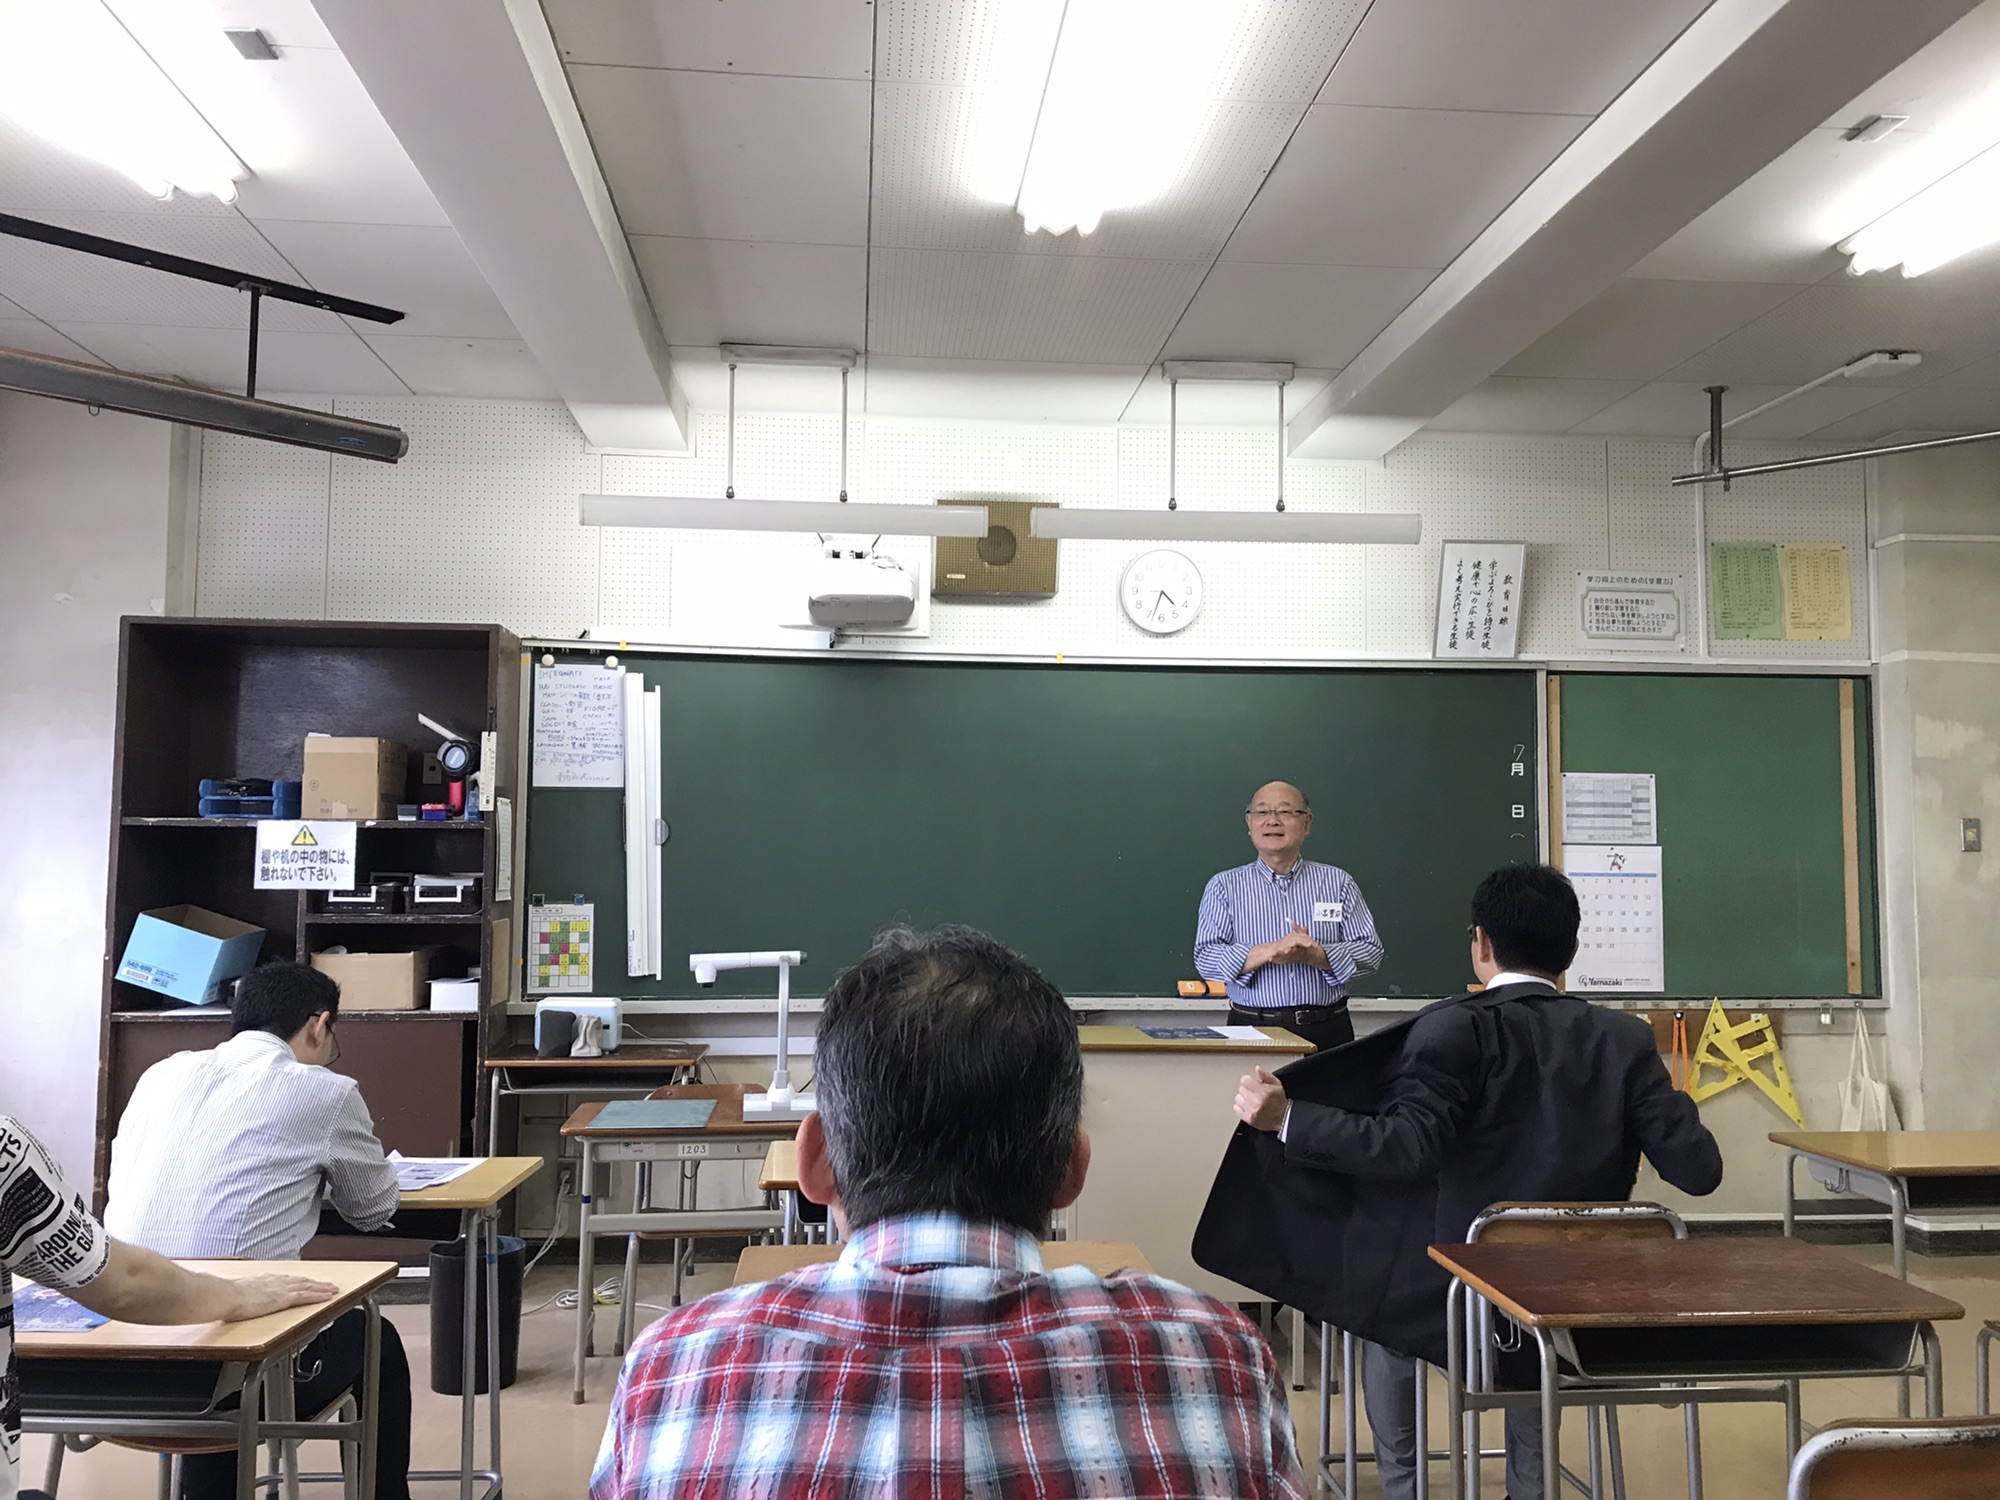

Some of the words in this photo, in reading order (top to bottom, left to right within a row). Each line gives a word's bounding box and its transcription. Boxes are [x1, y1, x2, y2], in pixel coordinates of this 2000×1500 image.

[1132, 586, 1139, 595] 9
[1186, 586, 1192, 596] 3
[1135, 600, 1142, 609] 8
[1182, 600, 1188, 608] 4
[1158, 613, 1165, 623] 6
[1172, 610, 1179, 619] 5
[261, 849, 349, 865] 棚や机の中の物には、
[260, 866, 337, 882] 触れないで下さい。
[1588, 977, 1622, 986] Yamazaki
[682, 1145, 706, 1154] 1203
[49, 1252, 84, 1273] THE
